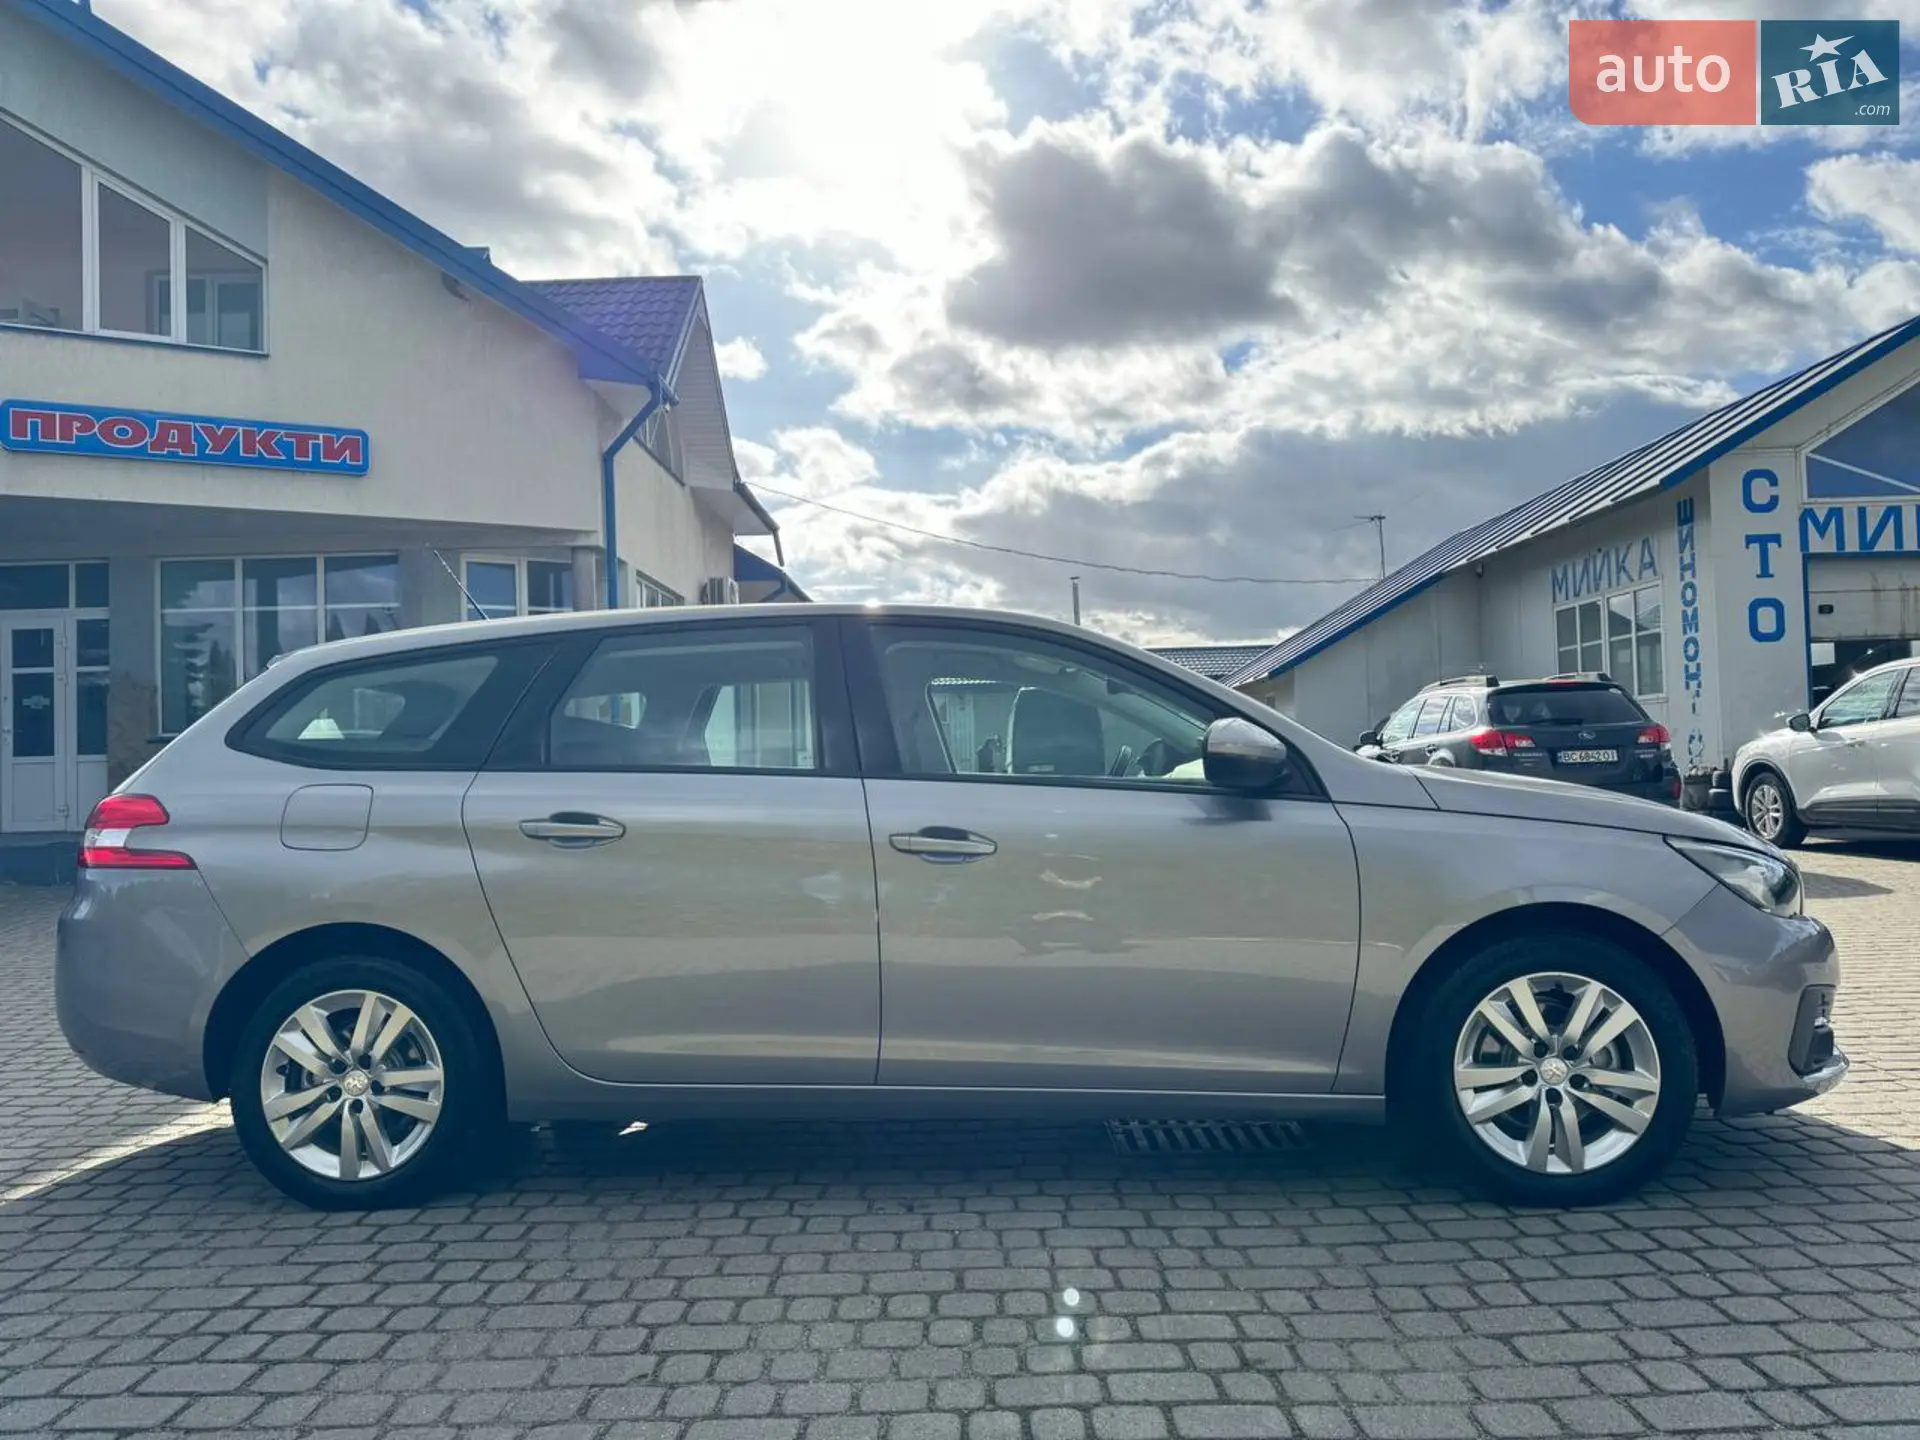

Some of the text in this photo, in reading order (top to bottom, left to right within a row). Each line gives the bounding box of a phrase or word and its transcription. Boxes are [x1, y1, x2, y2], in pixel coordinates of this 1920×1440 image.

[10, 407, 363, 465] ПРОДУКТИ
[1742, 469, 1786, 643] СТО
[1798, 504, 1920, 553] МИ
